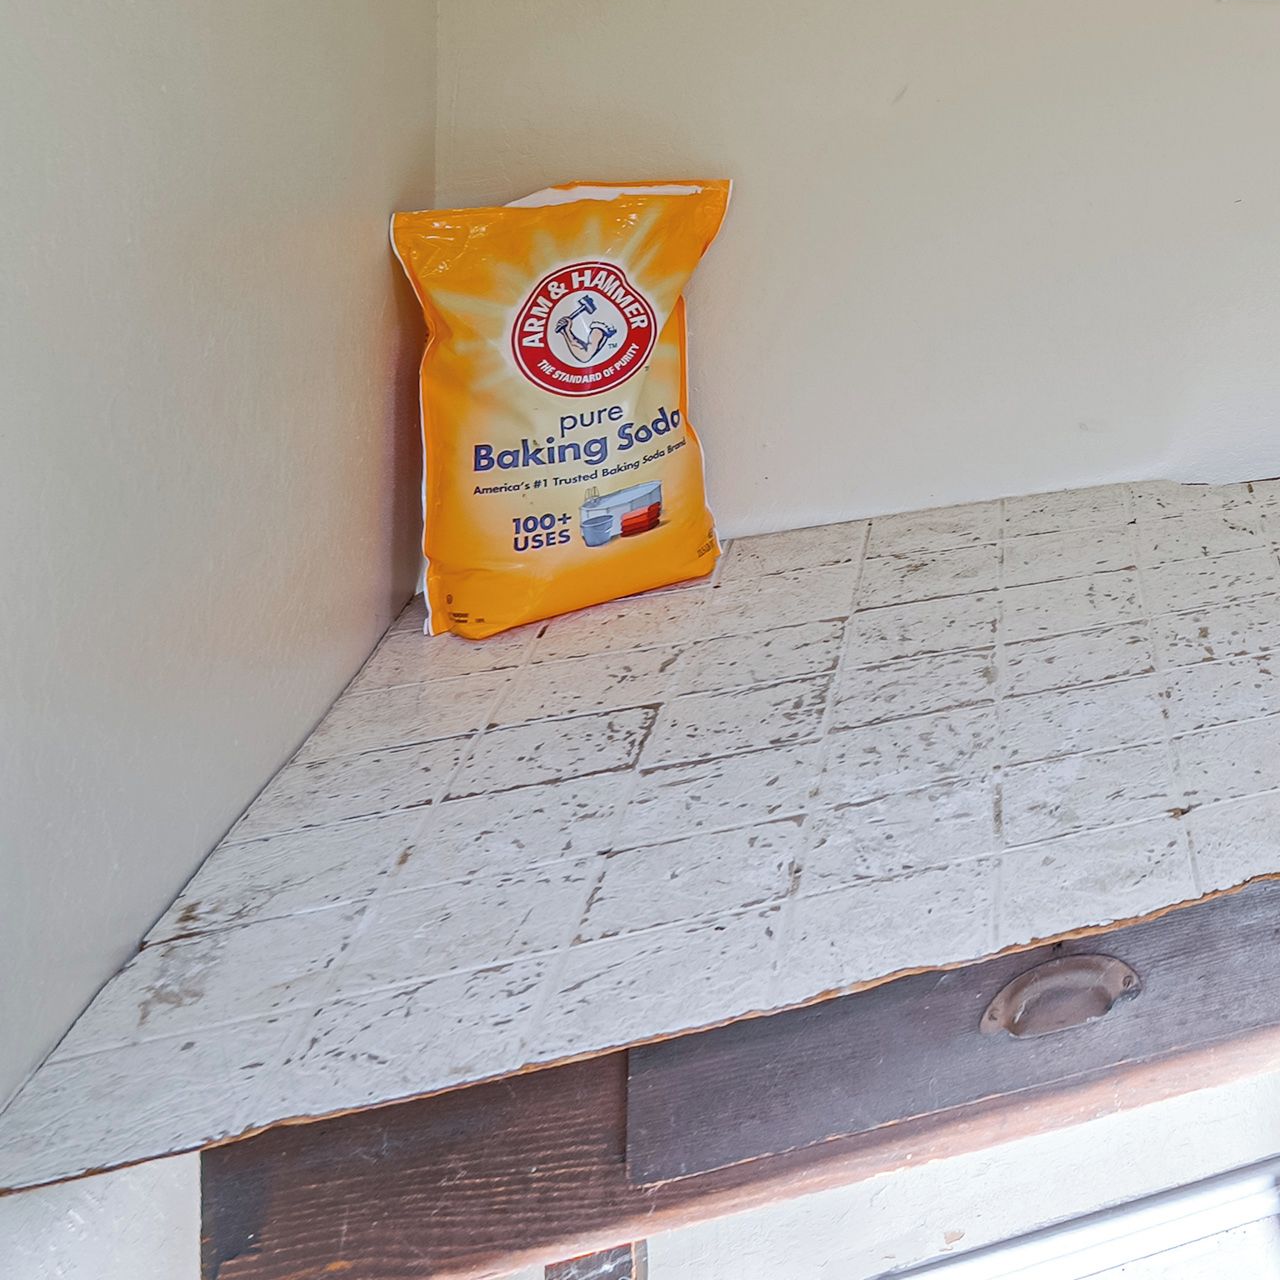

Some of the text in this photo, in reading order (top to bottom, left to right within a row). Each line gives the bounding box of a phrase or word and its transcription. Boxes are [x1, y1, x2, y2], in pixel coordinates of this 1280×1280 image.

[522, 270, 649, 348] ARM & HAMMER
[536, 342, 640, 384] THE STANDARD OF PURITY
[473, 406, 681, 472] Baking Soda
[560, 405, 624, 438] pure
[533, 478, 549, 489] #1
[552, 470, 599, 487] Trusted
[601, 458, 640, 478] Baking
[642, 450, 666, 465] Soda
[666, 438, 686, 455] Brand
[512, 512, 572, 535] 100+
[513, 528, 571, 552] USES
